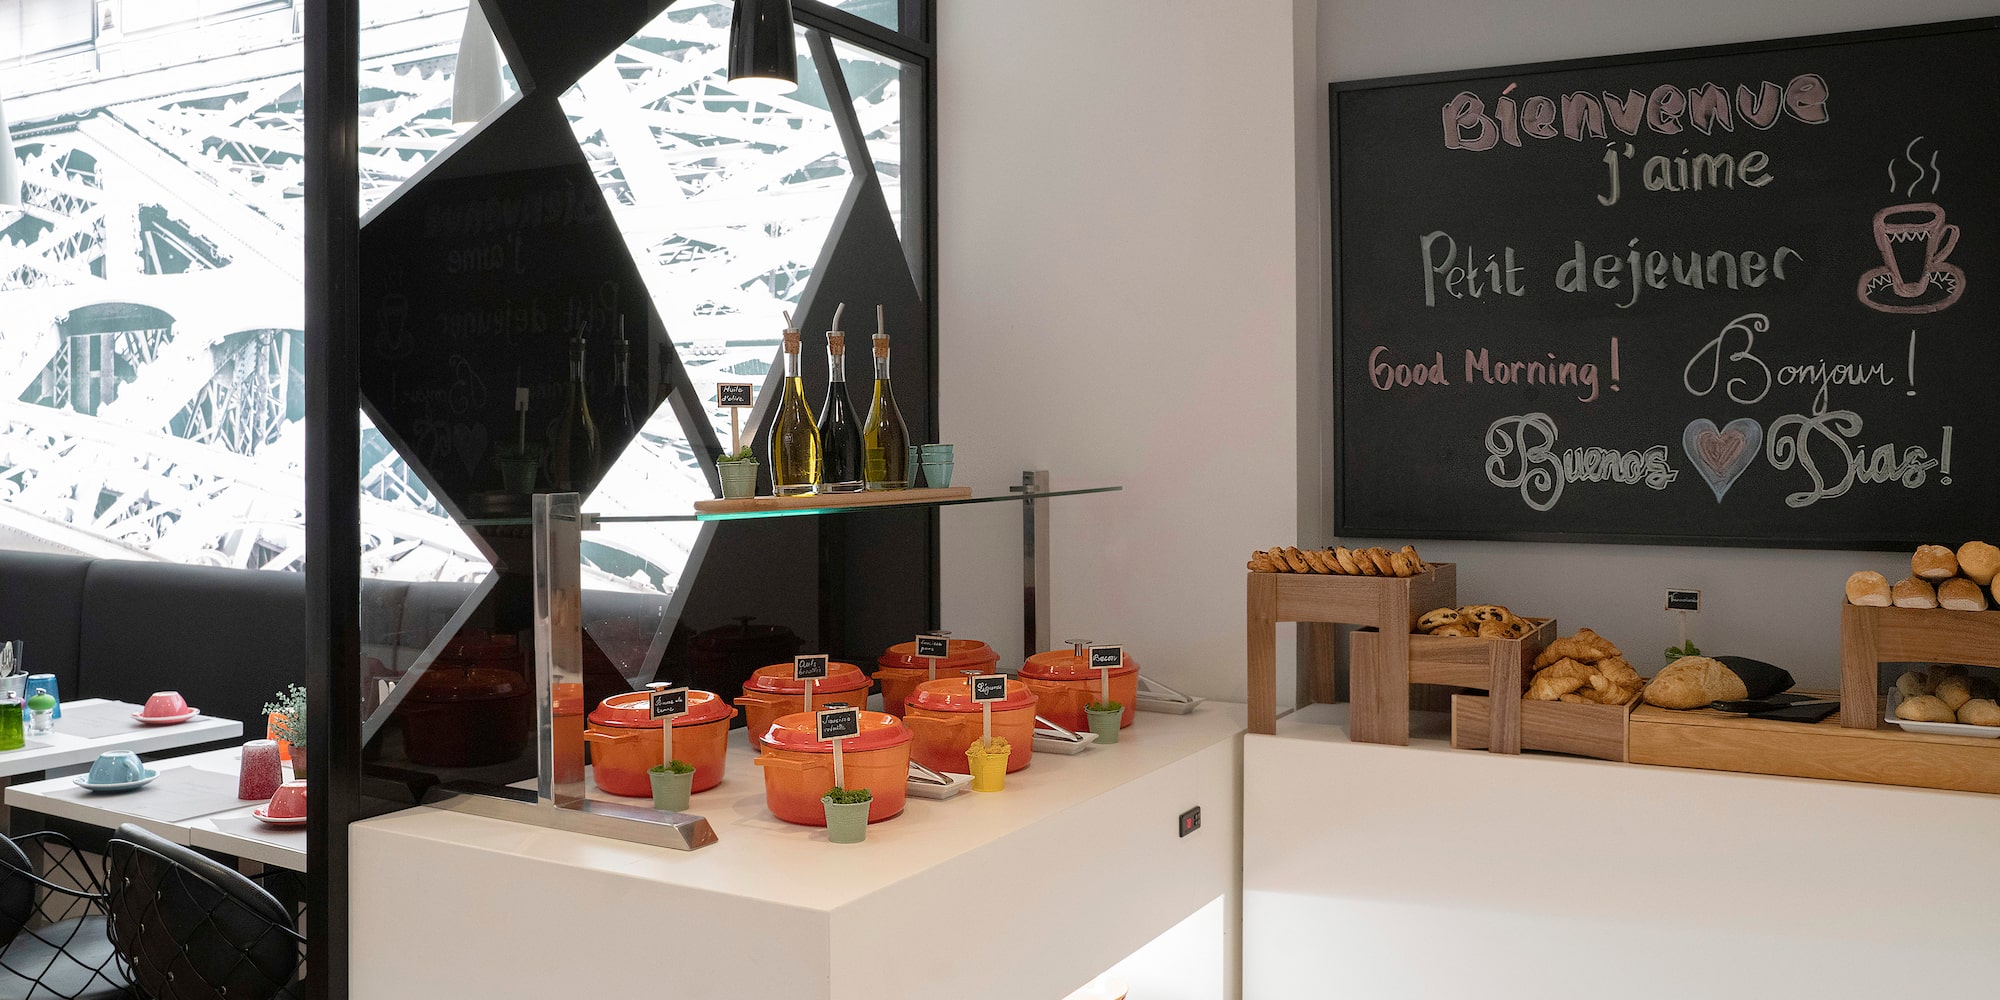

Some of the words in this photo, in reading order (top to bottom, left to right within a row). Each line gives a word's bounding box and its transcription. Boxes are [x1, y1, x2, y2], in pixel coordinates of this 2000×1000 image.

[1442, 73, 1830, 151] Bienvenue
[1598, 141, 1774, 206] j'aime
[1421, 231, 1526, 308] Petit
[1555, 237, 1803, 309] dejeuner
[1368, 346, 1447, 391] Good
[1484, 412, 1680, 511] Buenos
